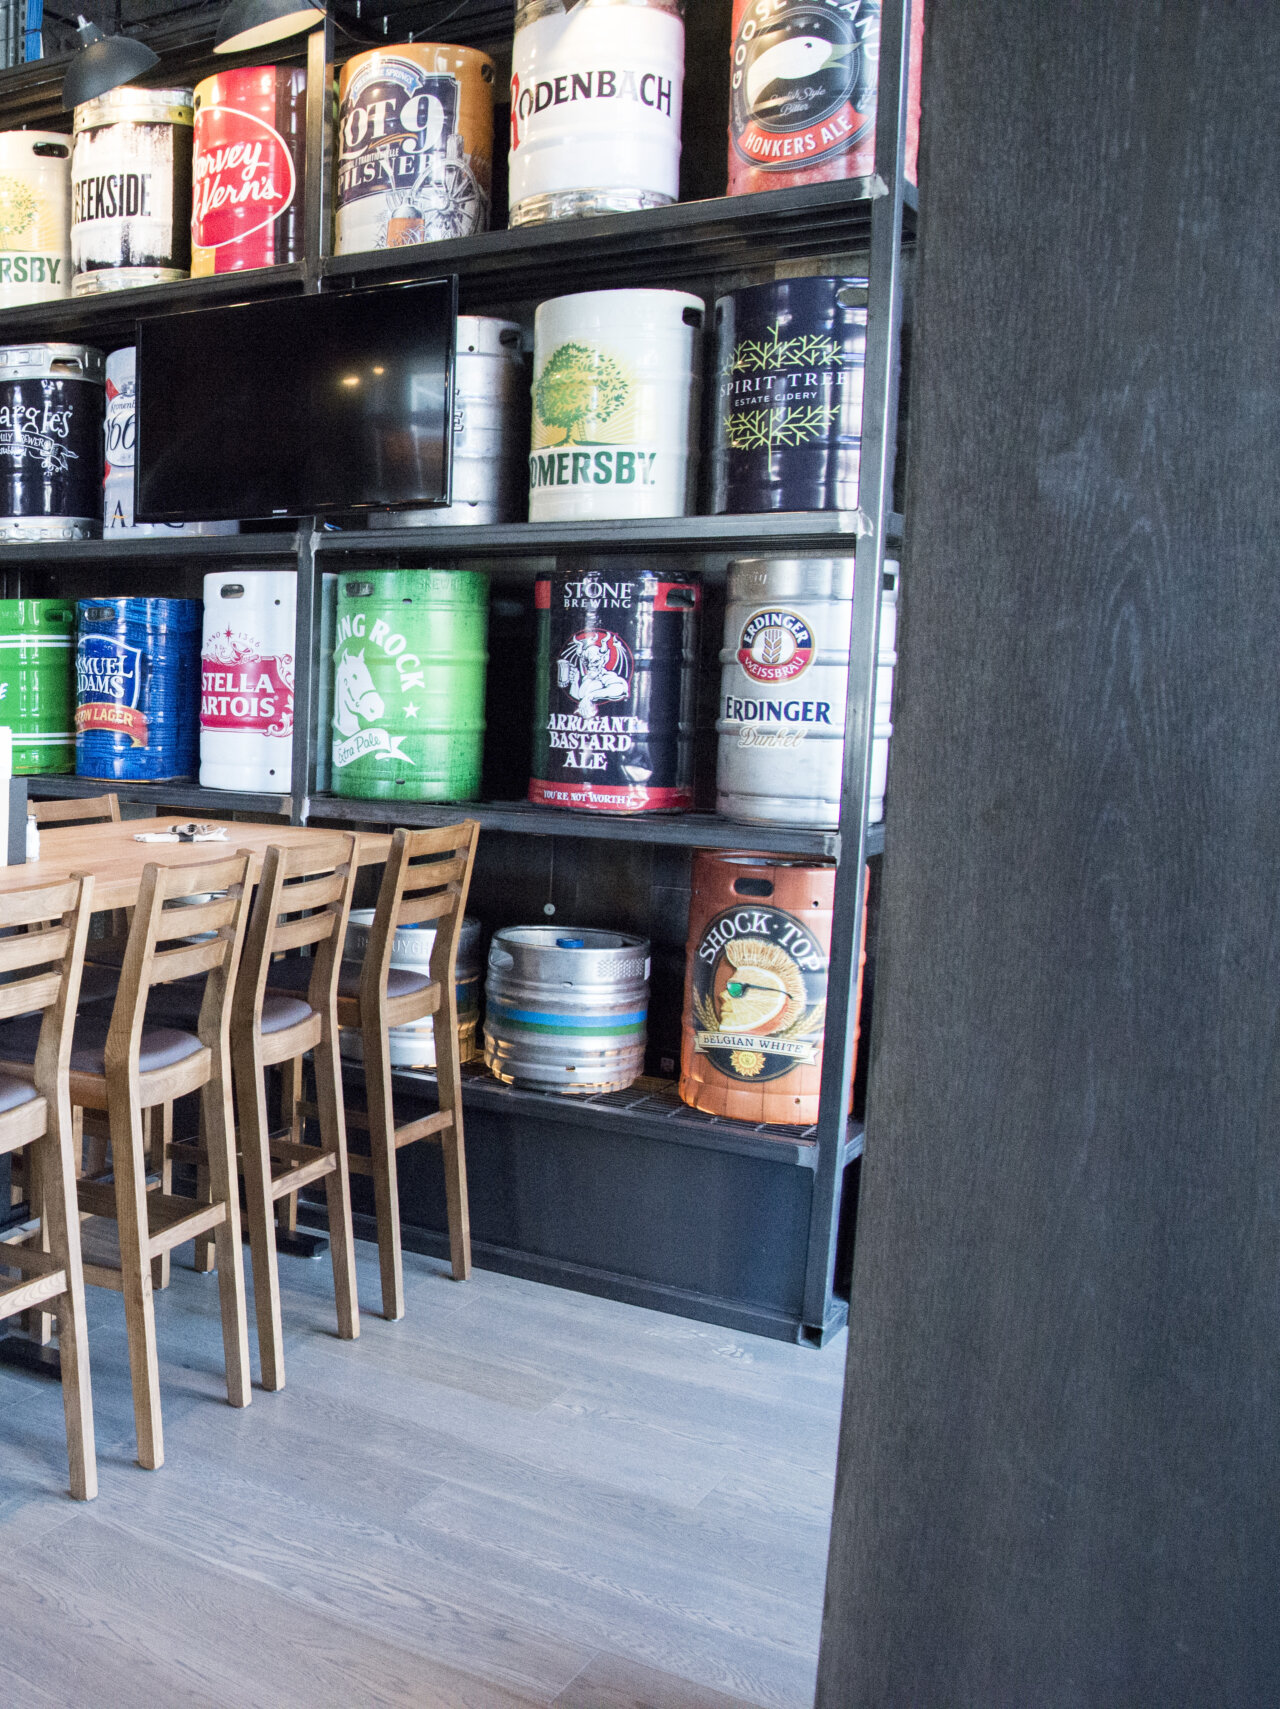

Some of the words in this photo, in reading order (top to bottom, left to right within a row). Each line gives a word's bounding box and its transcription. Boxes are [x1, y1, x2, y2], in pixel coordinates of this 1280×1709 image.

[800, 84, 828, 100] Style
[779, 101, 811, 116] Bitter
[401, 94, 445, 154] 9
[745, 132, 817, 158] HONKERS
[821, 115, 854, 144] ALE
[199, 173, 283, 222] Vern's
[720, 375, 777, 398] SPIRIT
[787, 371, 850, 387] TREE
[735, 395, 771, 407] ESTATE
[774, 391, 818, 403] CIDERY
[563, 581, 632, 599] STONE
[564, 599, 632, 609] BREWING
[743, 613, 810, 645] ERDINGER
[369, 618, 426, 694] ROCK
[202, 671, 276, 694] STELLA
[93, 708, 134, 727] LAGER
[201, 695, 276, 718] ARTOIS
[725, 696, 832, 726] ERDINGER
[547, 712, 639, 734] ARROGANT
[356, 732, 381, 754] Pale
[549, 730, 632, 752] BASTARD
[737, 725, 805, 748] Dunkel
[562, 750, 608, 771] ALE
[543, 790, 569, 801] YOU'RE
[570, 792, 588, 802] NOT
[587, 791, 634, 805] WORTHY
[699, 911, 773, 965] SHOCK
[778, 922, 821, 972] TOP
[703, 1033, 755, 1047] BELGIAN
[759, 1039, 804, 1053] WHITE
